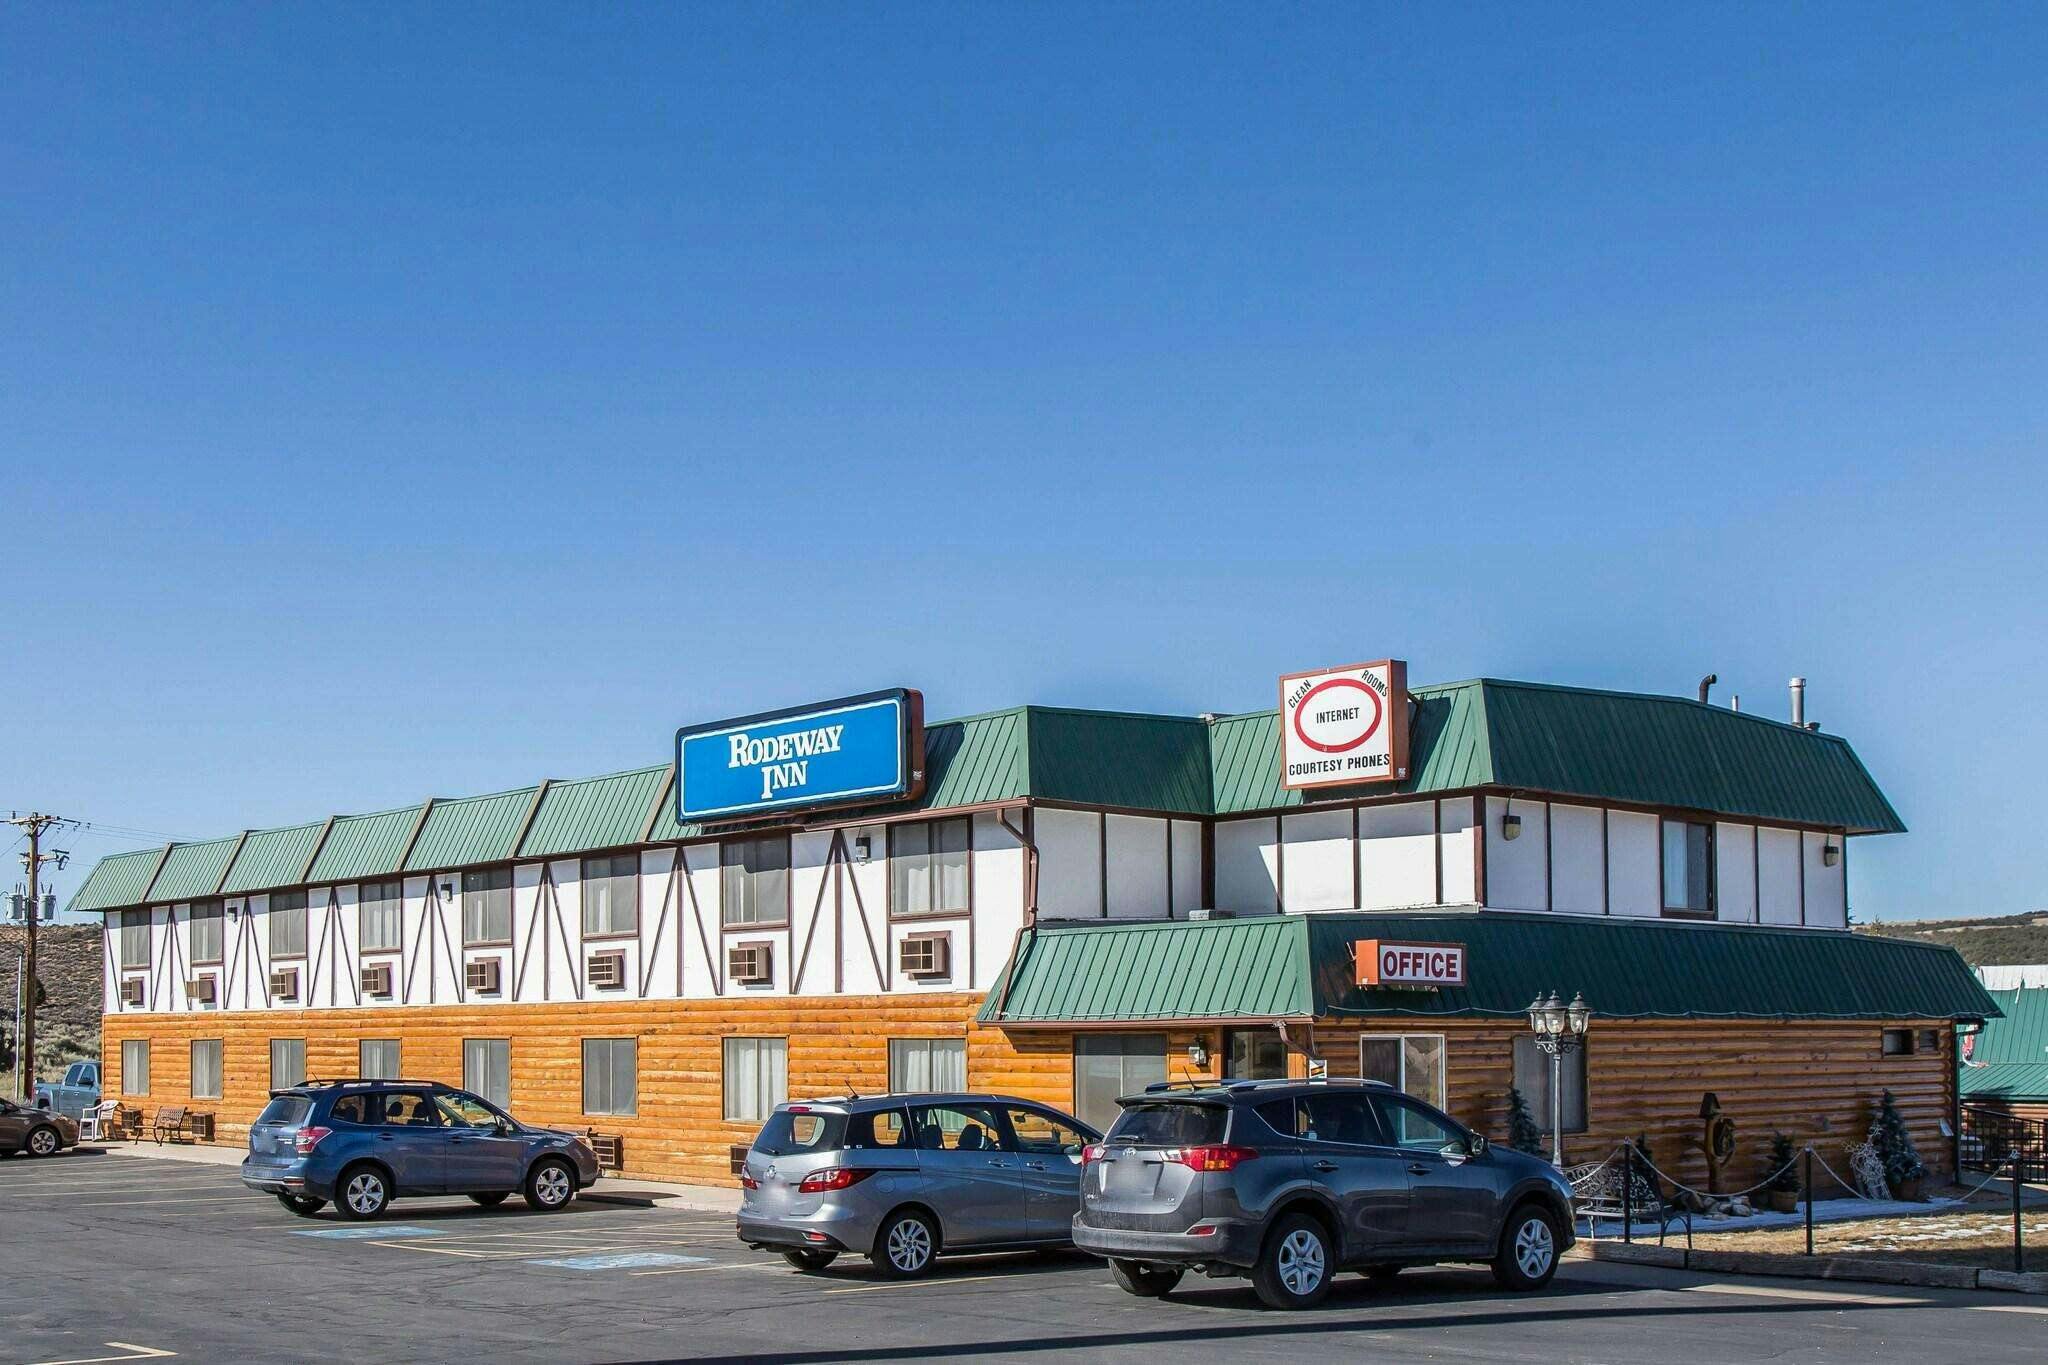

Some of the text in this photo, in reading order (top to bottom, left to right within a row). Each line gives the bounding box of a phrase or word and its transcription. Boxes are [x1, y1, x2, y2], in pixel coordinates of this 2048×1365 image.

[1288, 670, 1388, 709] CLEAN ROOMS
[1316, 707, 1360, 724] INTERNET
[1289, 753, 1390, 776] COURTESY PHONES
[761, 761, 808, 799] INN
[1383, 951, 1458, 978] OFFICE
